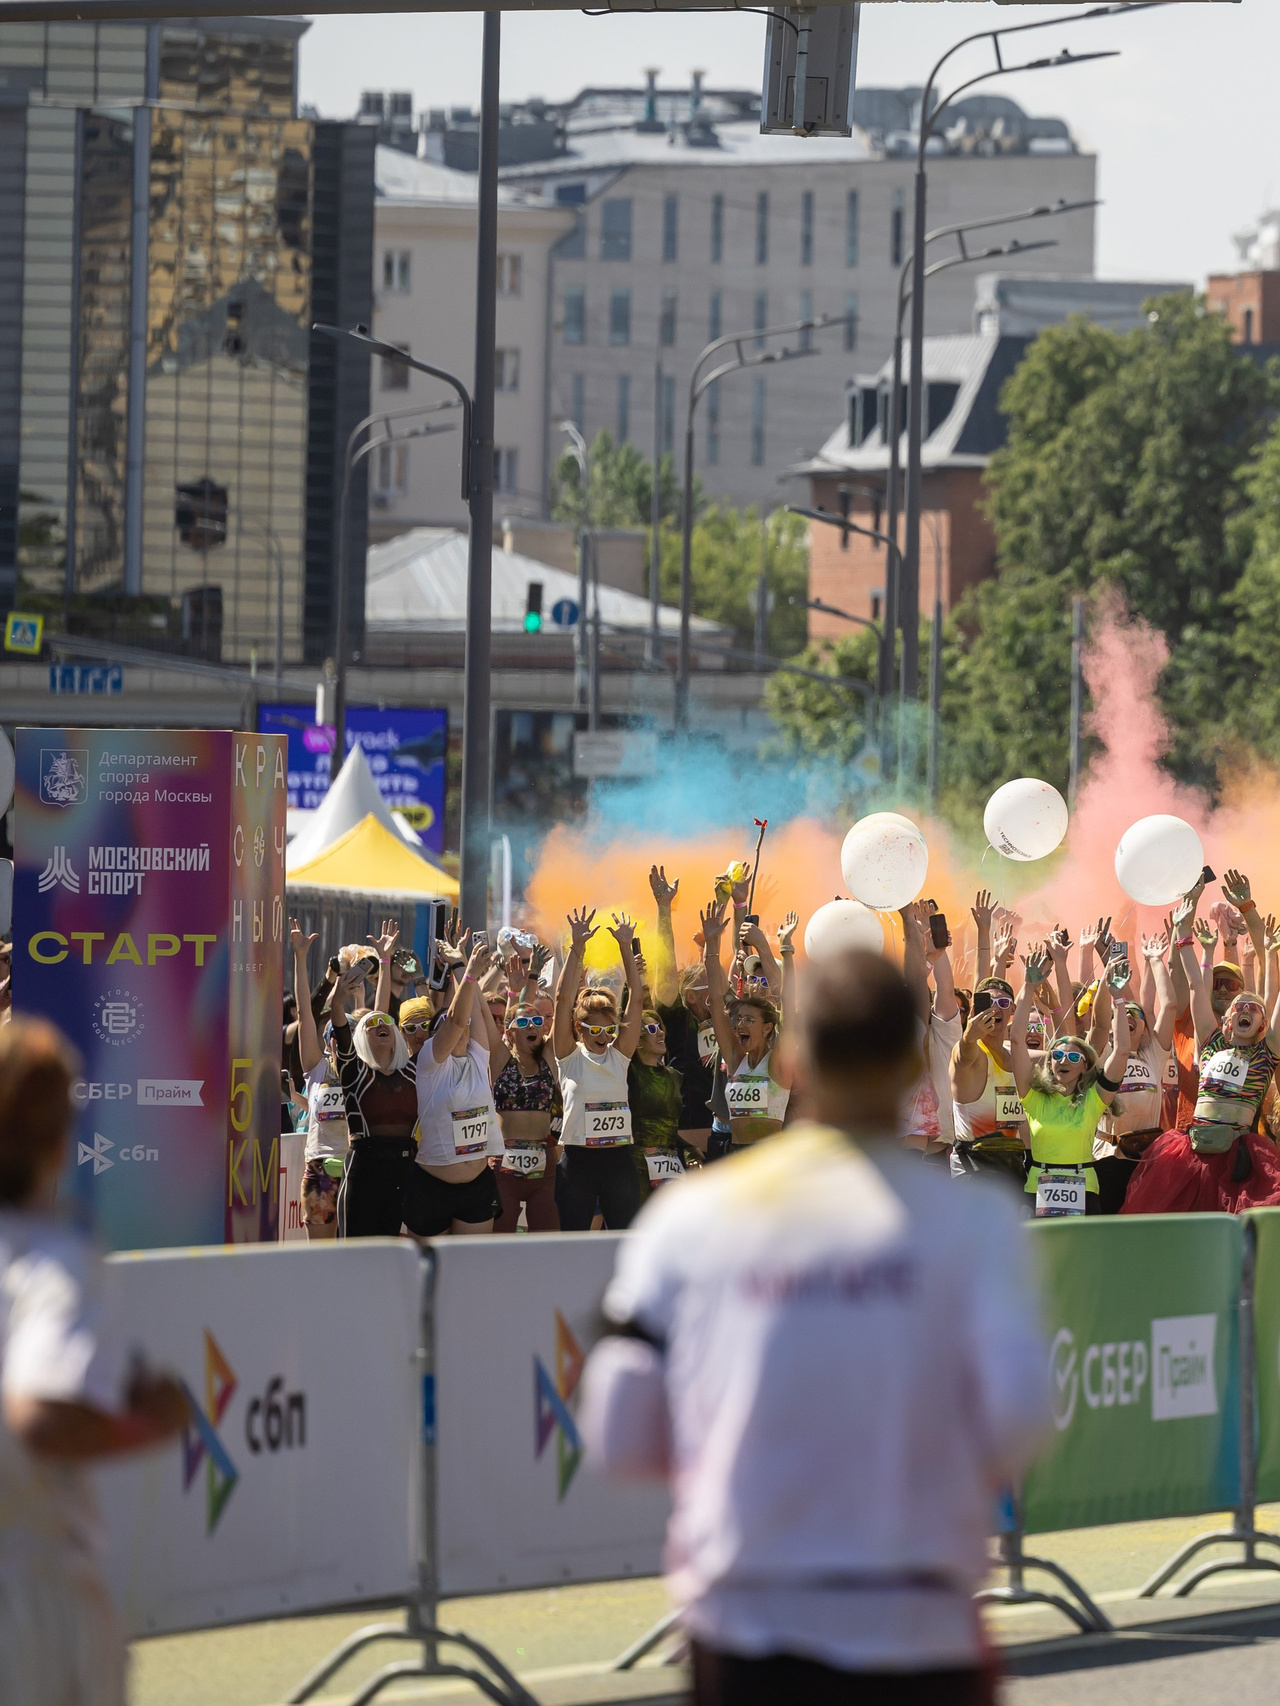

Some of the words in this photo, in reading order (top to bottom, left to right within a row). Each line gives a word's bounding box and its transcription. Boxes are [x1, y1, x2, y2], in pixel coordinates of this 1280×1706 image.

[99, 751, 197, 768] Департамент
[99, 772, 149, 786] спорта
[99, 790, 150, 803] города
[154, 789, 212, 803] Москвы
[88, 843, 210, 872] МОСКОВСКИЙ
[88, 871, 146, 895] СПОРТ
[28, 931, 217, 967] СТАРТ
[232, 963, 264, 972] ЗАБЕГ
[94, 989, 143, 1008] БЕГОВОЕ
[92, 1022, 145, 1047] СООБЩЕСТВО
[74, 1082, 132, 1100] СБЕР
[144, 1085, 191, 1100] Прайм
[230, 1058, 252, 1132] 5
[729, 1088, 761, 1102] 2668
[461, 1121, 487, 1139] 1797
[593, 1116, 625, 1131] 2673
[119, 1144, 159, 1162] сбп
[508, 1155, 539, 1169] 7139
[653, 1160, 682, 1174] 7742
[1044, 1189, 1078, 1203] 7650
[1082, 1340, 1148, 1410] СБЕР
[245, 1374, 306, 1454] сбп
